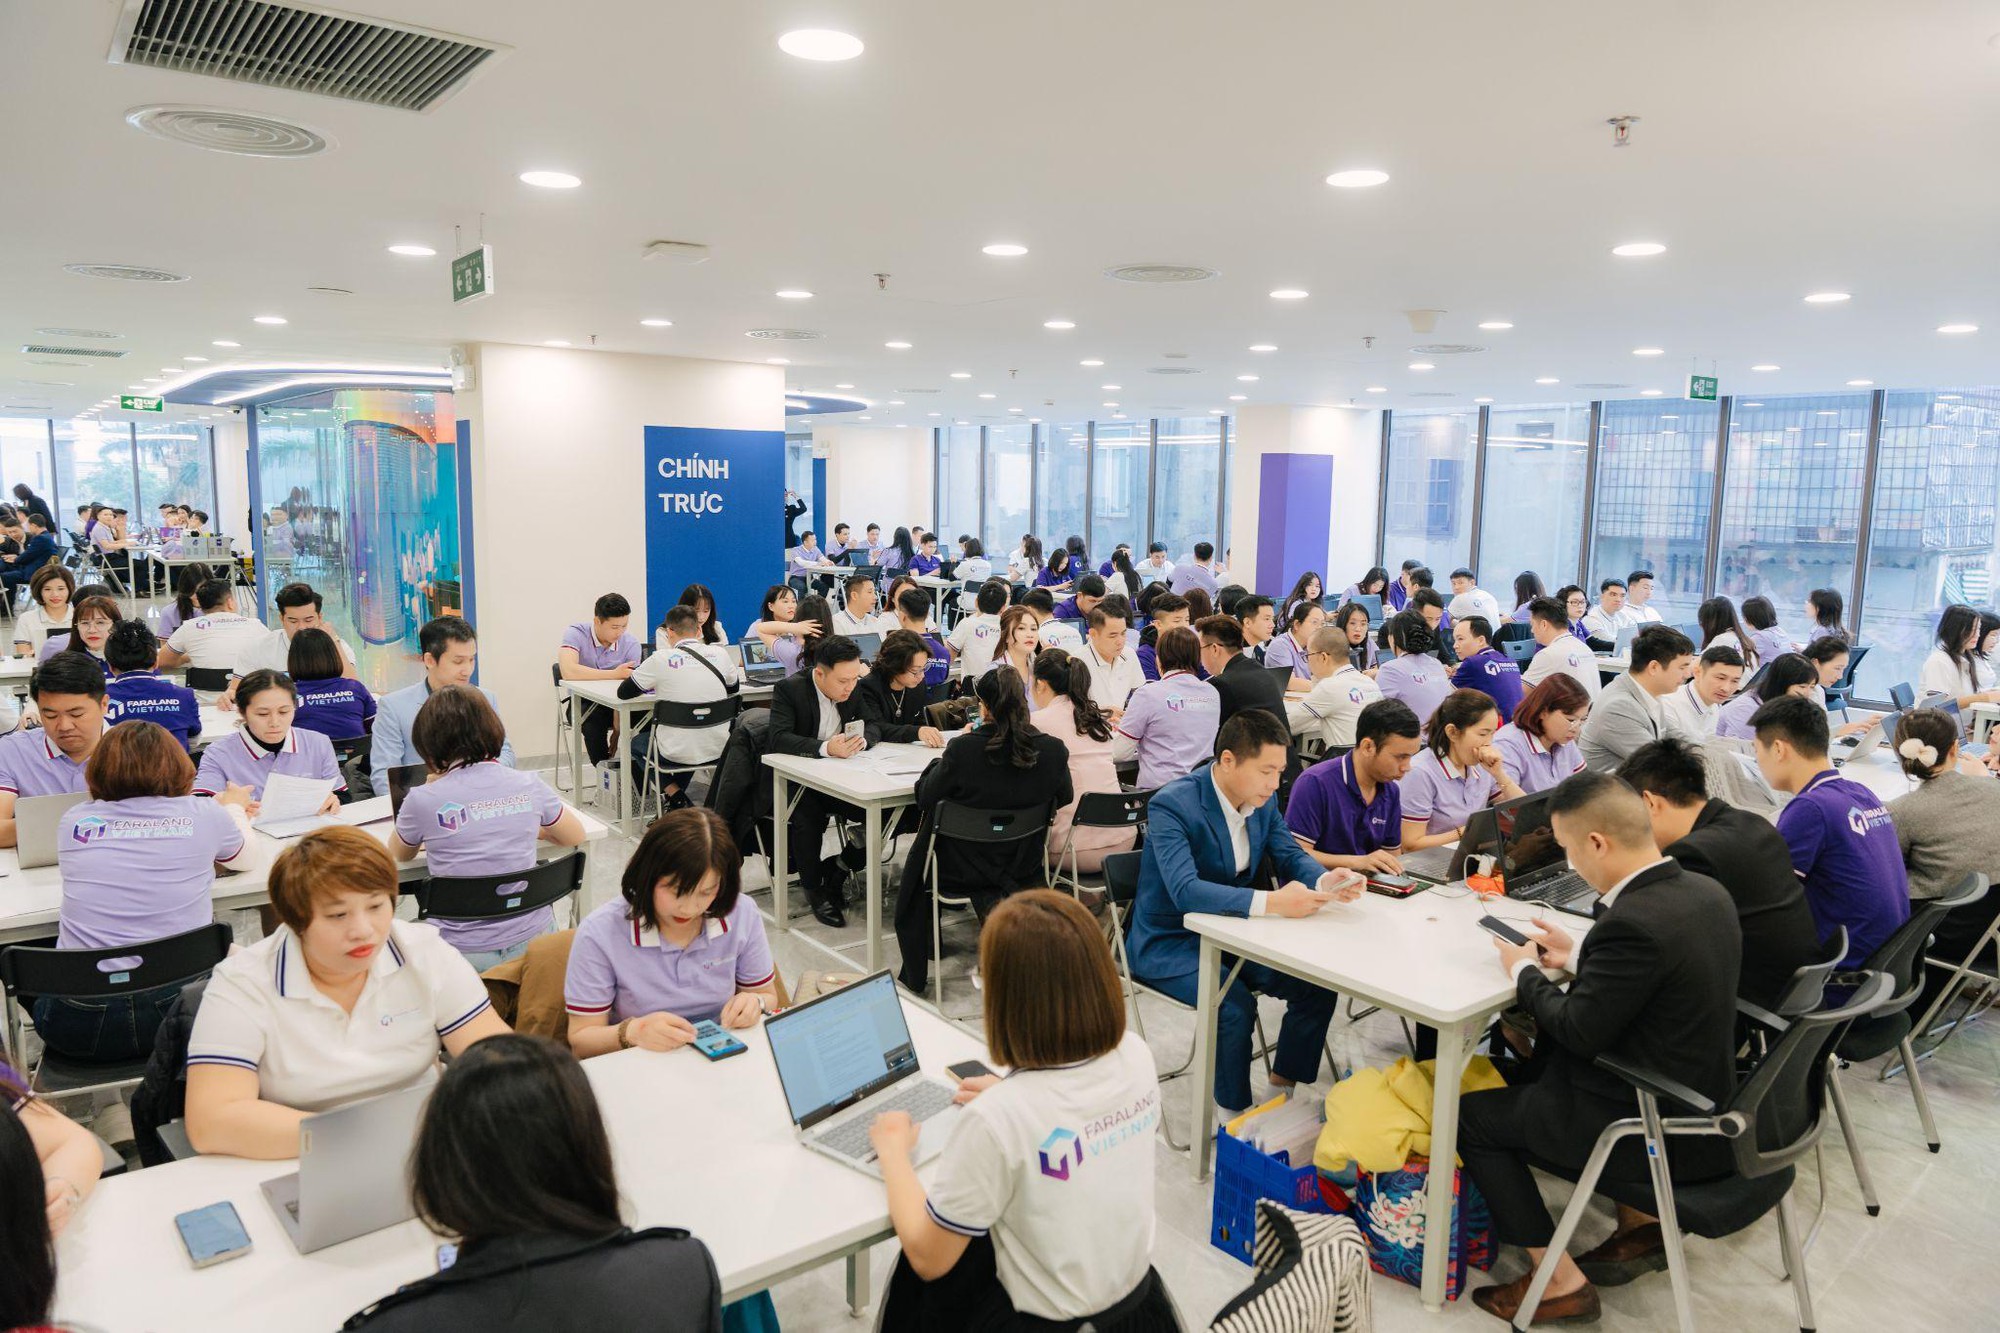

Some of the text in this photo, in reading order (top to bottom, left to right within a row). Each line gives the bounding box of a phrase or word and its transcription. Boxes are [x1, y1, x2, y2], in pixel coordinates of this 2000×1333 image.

[658, 452, 729, 479] CHÍNH
[658, 490, 724, 519] TRỰC
[306, 690, 354, 700] FARALAND
[307, 696, 355, 705] VIETNAM
[126, 698, 180, 707] FARALAND
[127, 705, 180, 714] VIETNAM
[469, 794, 530, 811] FARALAND
[113, 818, 193, 830] FARALAND
